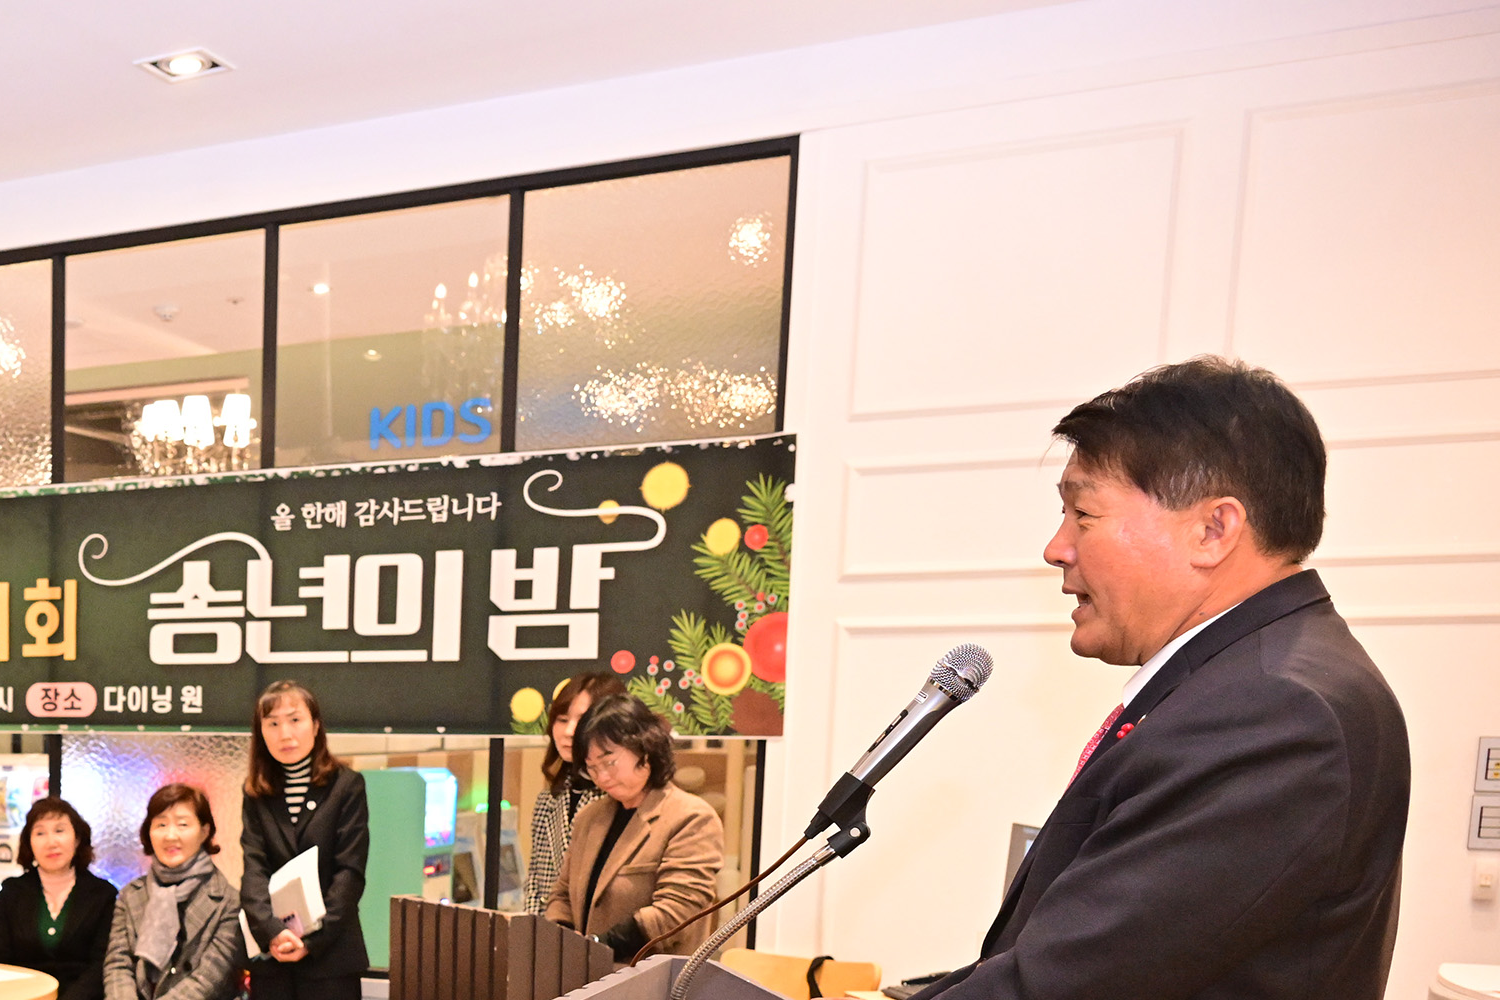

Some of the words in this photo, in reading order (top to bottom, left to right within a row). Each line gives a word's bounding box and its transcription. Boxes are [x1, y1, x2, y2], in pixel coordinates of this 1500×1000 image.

[368, 397, 493, 451] KIDS
[271, 504, 295, 531] 올
[301, 501, 348, 529] 한해
[353, 492, 501, 527] 감사드립니다
[40, 688, 83, 712] 장소
[104, 686, 174, 714] 다이닝
[181, 685, 204, 713] 원
